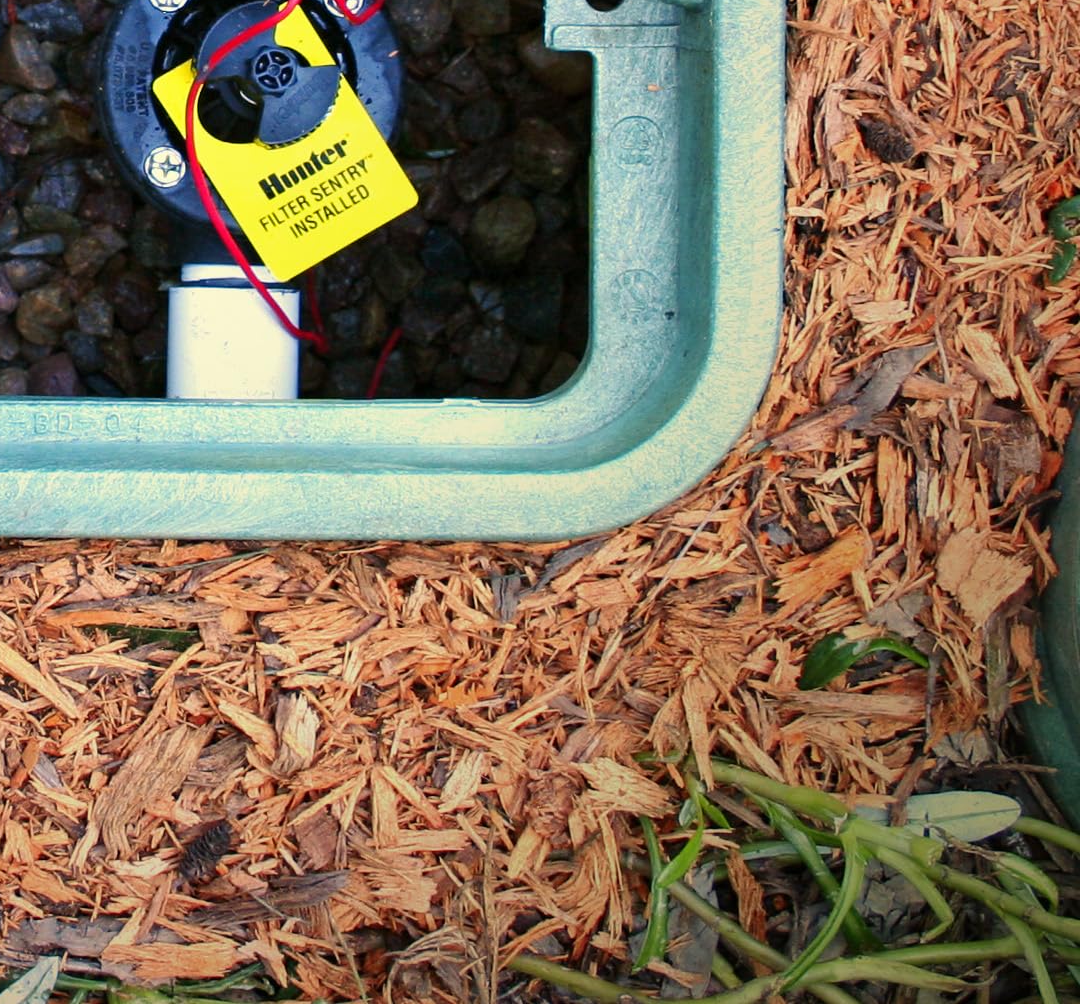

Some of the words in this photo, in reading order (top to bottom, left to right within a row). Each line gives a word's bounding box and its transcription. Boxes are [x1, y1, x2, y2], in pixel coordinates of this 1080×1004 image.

[258, 139, 348, 200] Hunter
[259, 195, 311, 232] FILTER
[309, 158, 369, 202] SENTRY
[289, 184, 370, 238] INSTALLED
